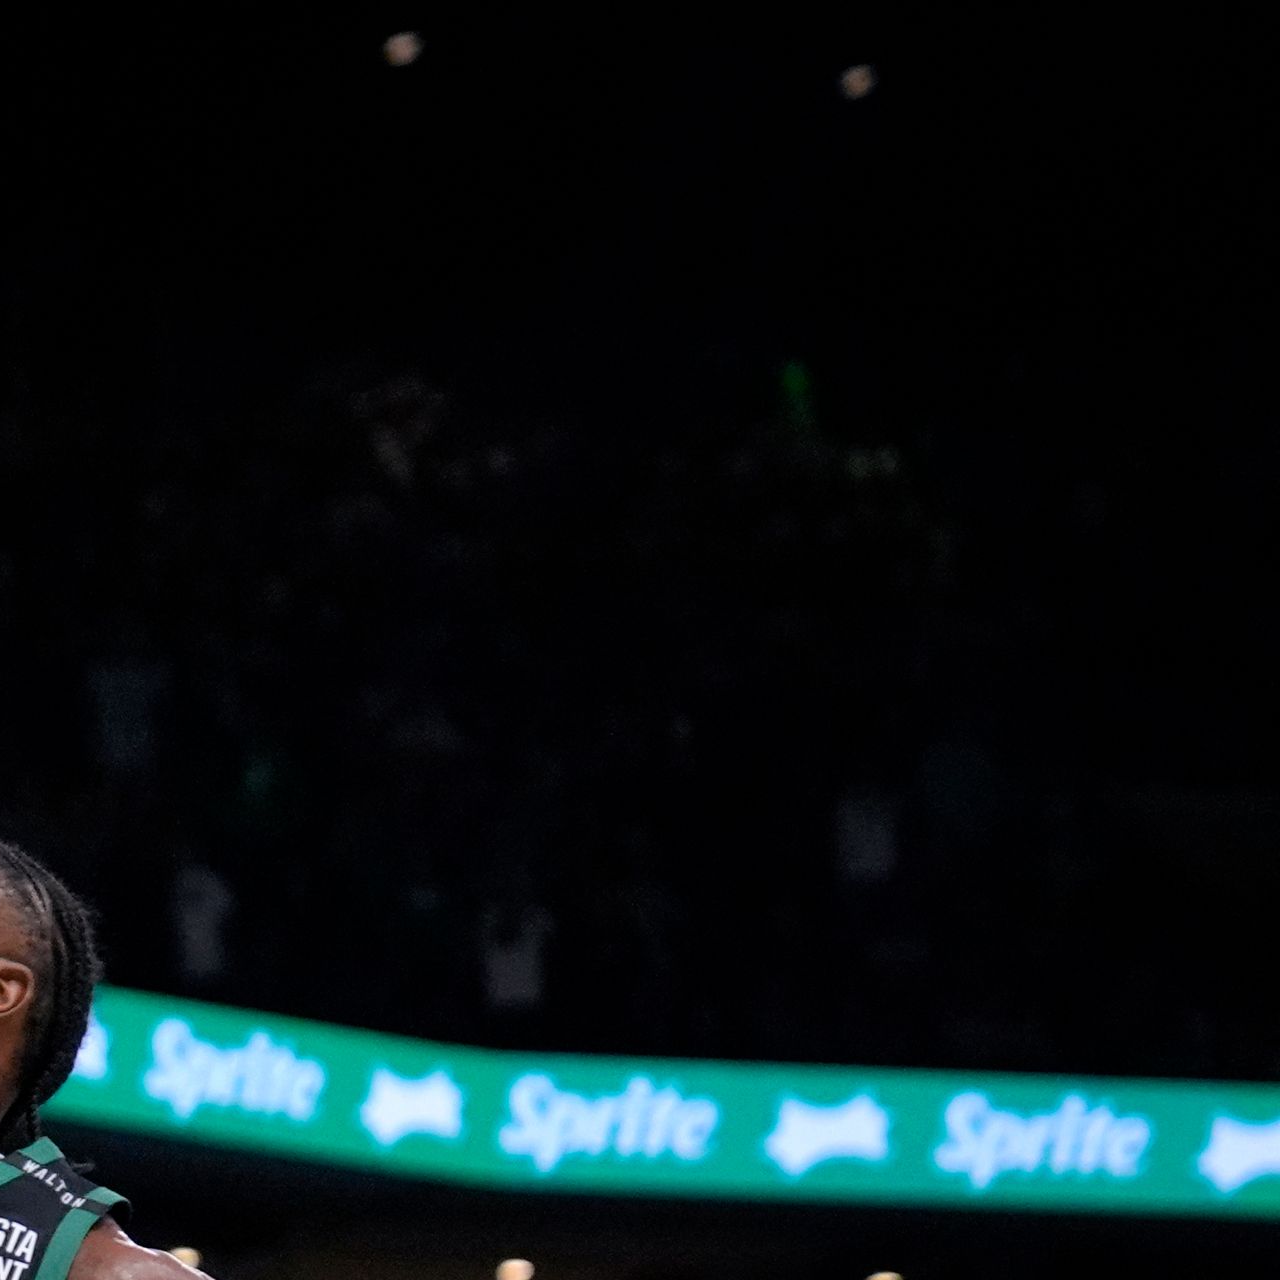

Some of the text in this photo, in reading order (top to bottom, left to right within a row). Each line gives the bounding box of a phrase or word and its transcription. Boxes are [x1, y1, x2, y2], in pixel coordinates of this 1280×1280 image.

[143, 1019, 324, 1119] Sprite
[498, 1075, 717, 1171] Sprite
[934, 1092, 1149, 1187] Sprite
[22, 1159, 87, 1208] WALTON
